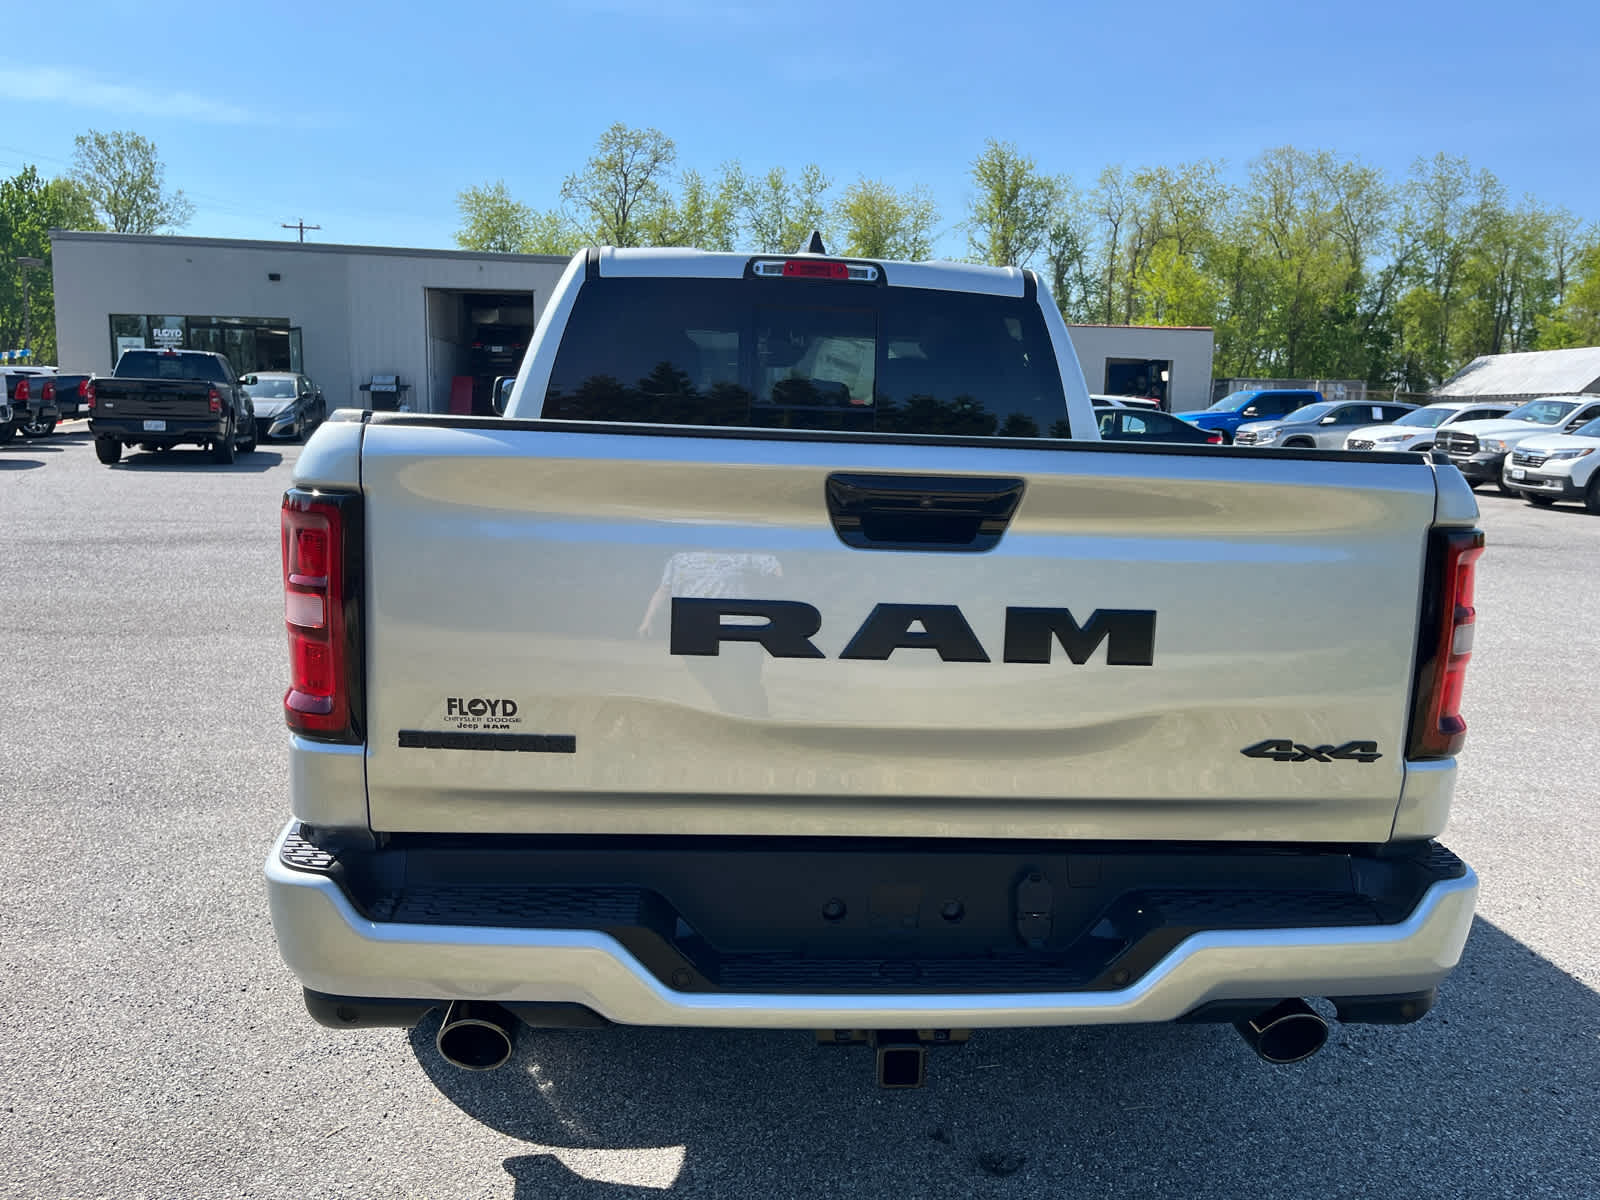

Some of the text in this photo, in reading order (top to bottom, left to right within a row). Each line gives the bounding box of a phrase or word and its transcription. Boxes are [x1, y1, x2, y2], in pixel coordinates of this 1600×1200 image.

[153, 329, 183, 337] FLOYD
[670, 597, 1157, 666] RAM
[447, 698, 518, 717] FLOYD
[457, 722, 479, 730] Jeep
[1240, 739, 1383, 762] 4x4
